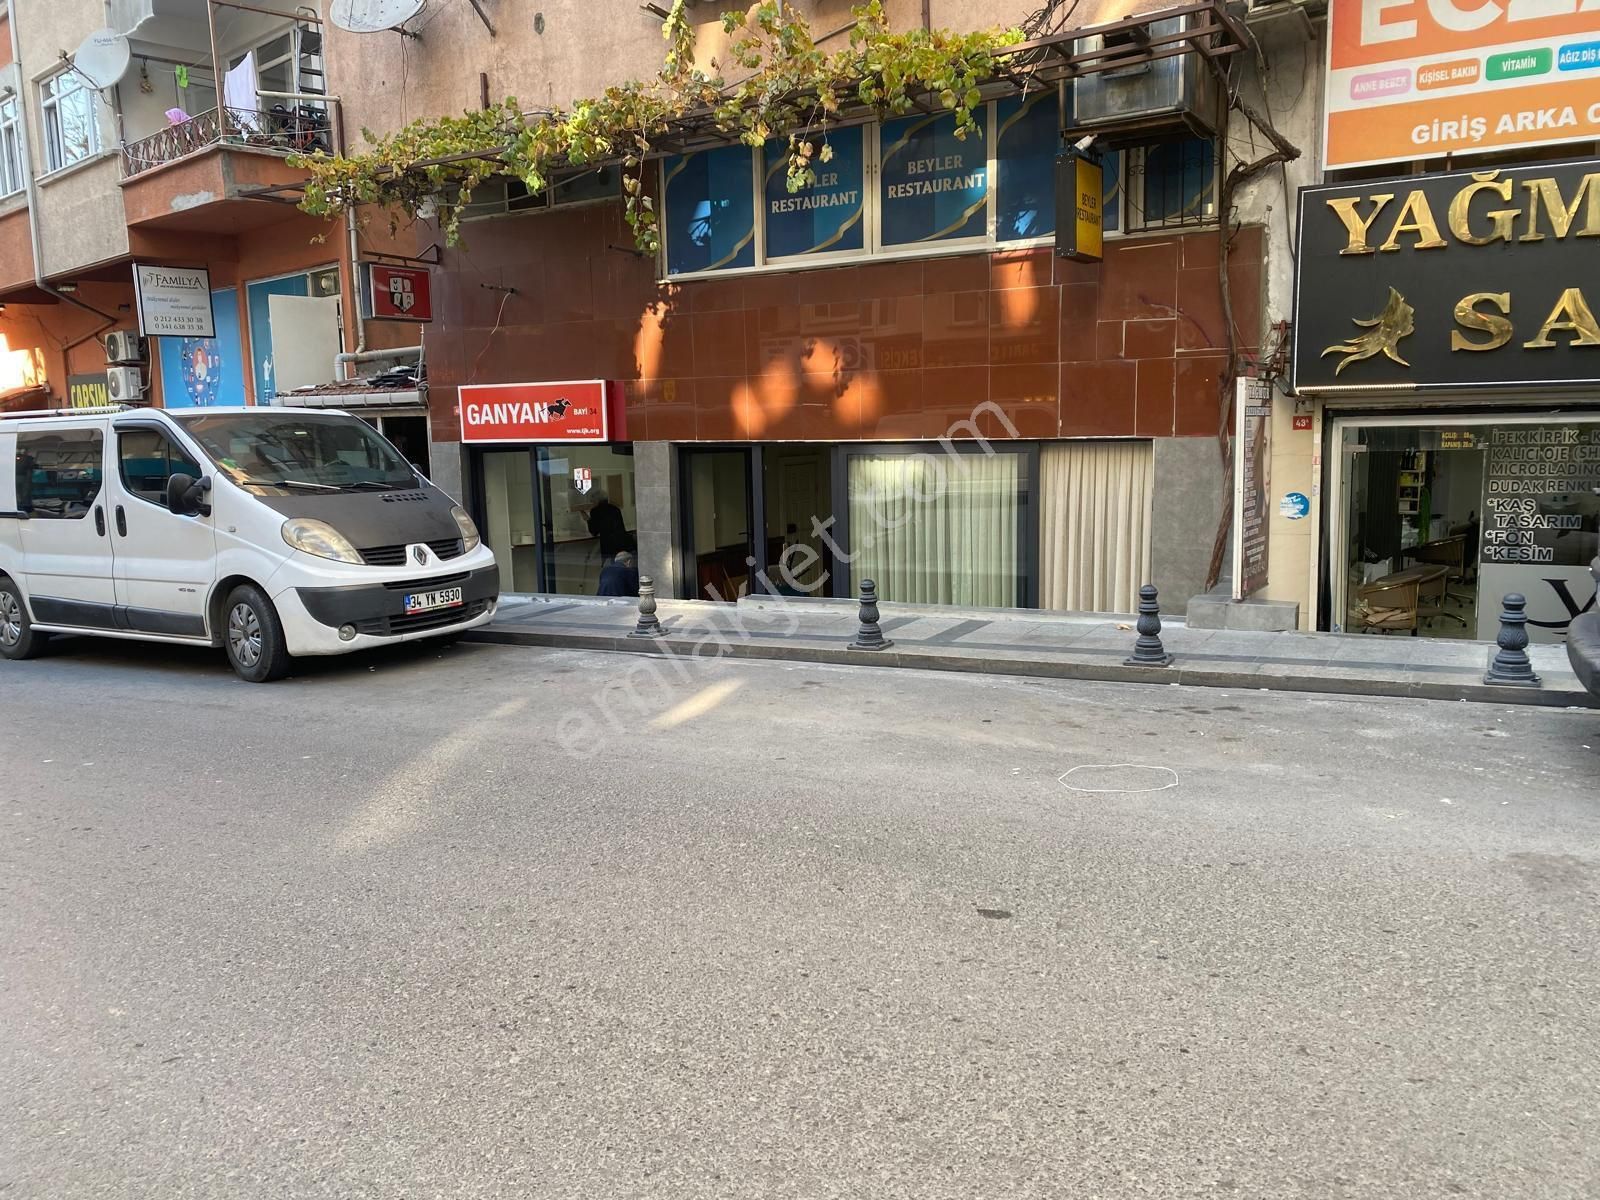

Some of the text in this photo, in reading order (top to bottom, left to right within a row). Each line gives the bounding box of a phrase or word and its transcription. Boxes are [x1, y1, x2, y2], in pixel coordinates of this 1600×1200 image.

[1502, 56, 1537, 73] VİTAMİN
[1560, 47, 1597, 65] AĞIZ DİŞ
[1353, 76, 1408, 94] ANNE BEBEK
[1419, 65, 1478, 85] KİŞİSEL BAKIM
[1411, 115, 1487, 145] GİRİŞ
[1495, 106, 1579, 135] ARKA
[907, 154, 963, 175] BEYLER
[887, 173, 985, 199] RESTAURANT
[771, 190, 858, 214] RESTAURANT
[1326, 169, 1600, 256] YAĞM
[1451, 287, 1600, 352] SA
[467, 402, 549, 425] GANYAN
[573, 407, 588, 416] BAYİ
[1492, 428, 1525, 444] İPEK
[1528, 427, 1579, 444] KİRPİK
[1492, 448, 1540, 462] KALICI
[1544, 447, 1568, 462] OJE
[1489, 480, 1544, 493] DUDAK
[1494, 514, 1582, 529] TASARIM
[410, 588, 460, 608] 34 YN 5930
